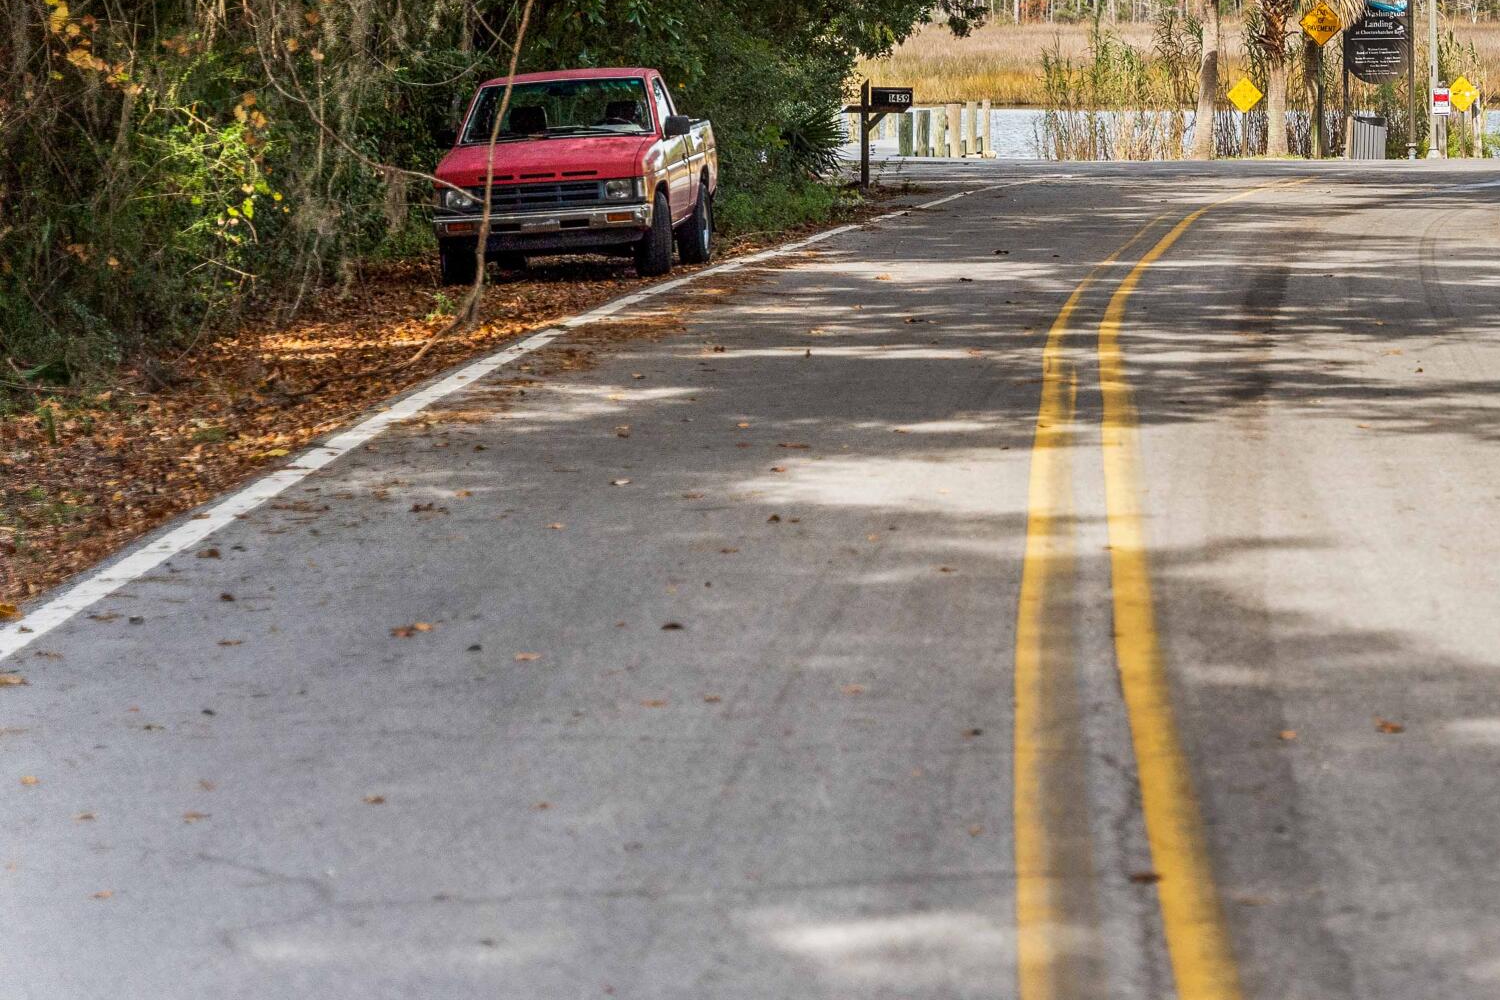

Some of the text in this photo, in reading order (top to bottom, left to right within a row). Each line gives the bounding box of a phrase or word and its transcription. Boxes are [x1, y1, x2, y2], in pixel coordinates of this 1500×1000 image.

[1364, 9, 1405, 19] Washington
[1307, 24, 1337, 32] PAVEMENT
[1364, 20, 1393, 29] Landing
[889, 94, 909, 102] 1459
